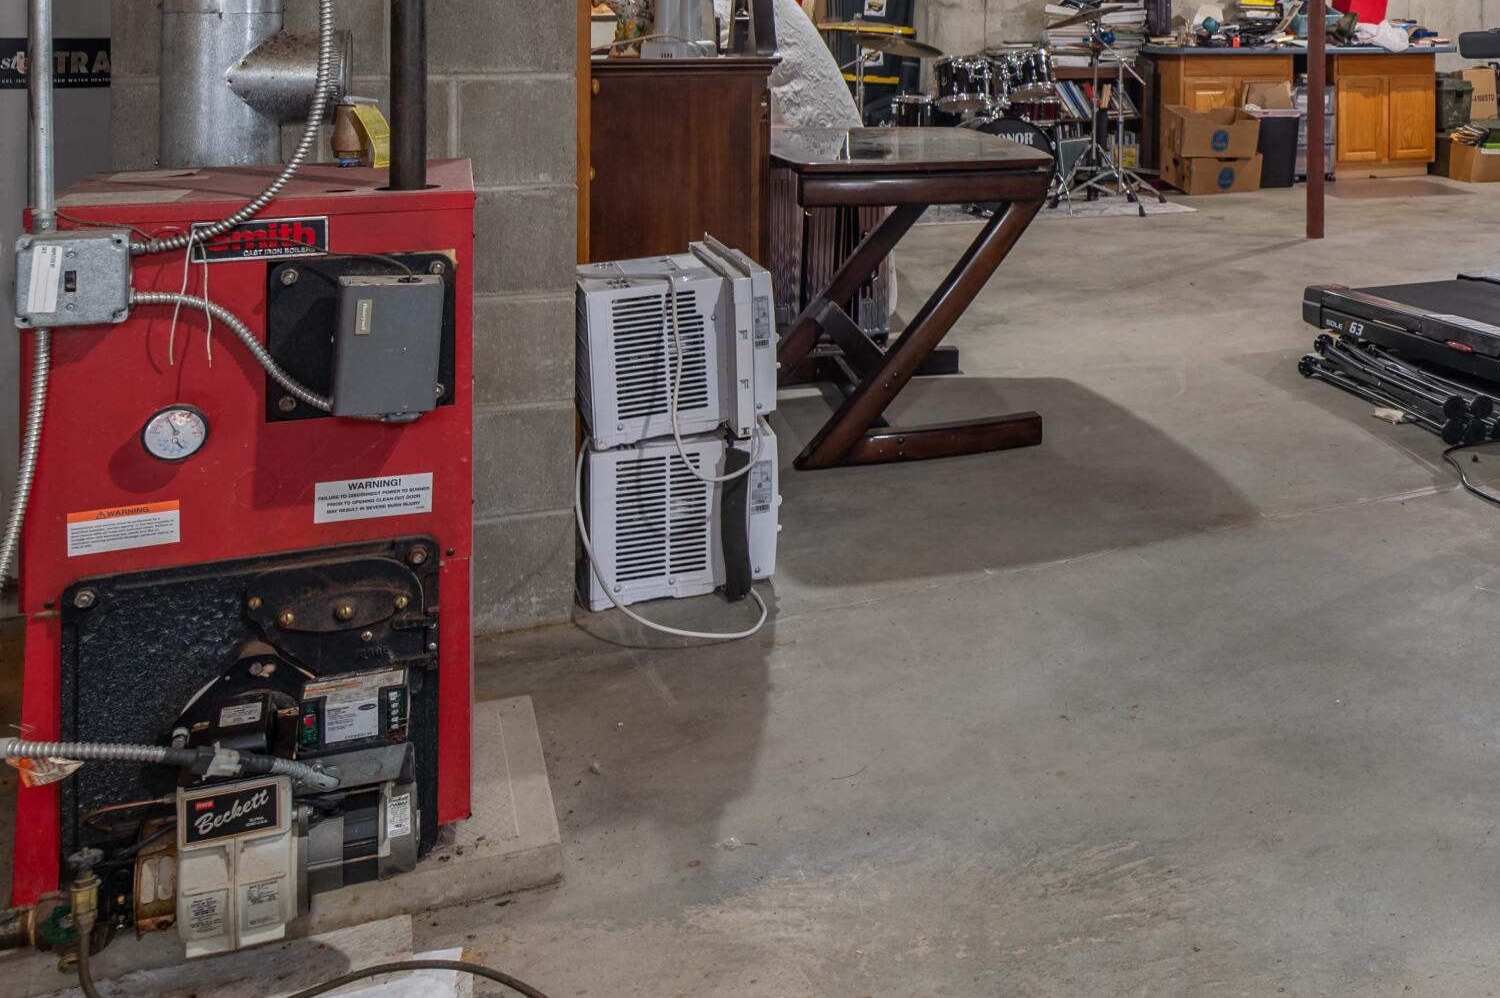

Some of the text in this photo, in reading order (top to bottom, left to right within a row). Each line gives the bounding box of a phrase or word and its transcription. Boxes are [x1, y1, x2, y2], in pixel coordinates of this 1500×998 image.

[998, 132, 1035, 145] NOR
[243, 249, 263, 257] CAST
[1325, 318, 1343, 330] SOLE
[348, 478, 402, 491] WARNING!
[107, 506, 150, 517] WARNING
[194, 788, 270, 835] Beckett
